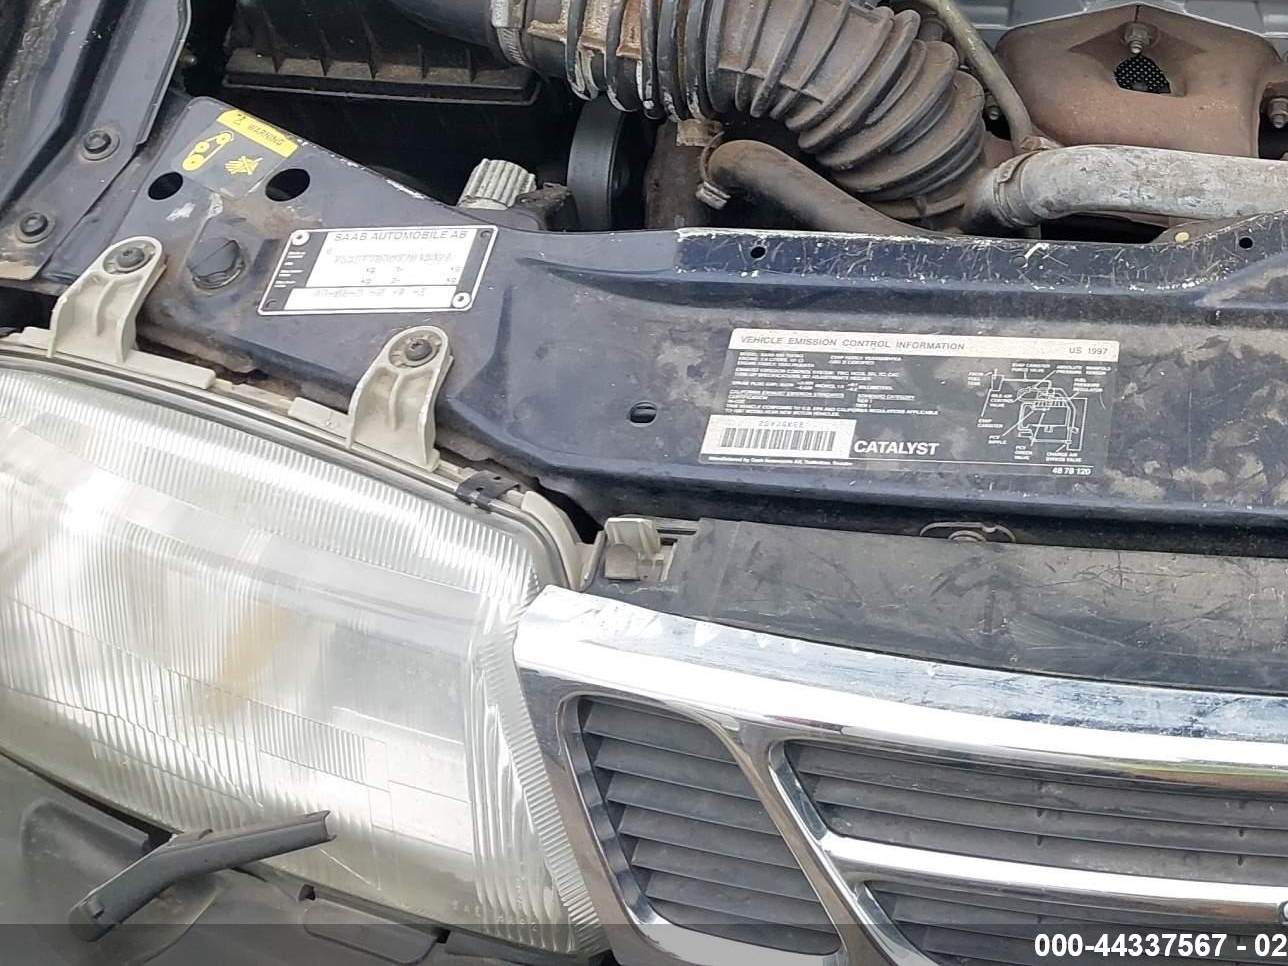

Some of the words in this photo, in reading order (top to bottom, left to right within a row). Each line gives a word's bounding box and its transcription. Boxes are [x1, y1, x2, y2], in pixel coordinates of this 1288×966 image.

[247, 123, 285, 146] WARNING
[334, 233, 368, 241] SAAB
[370, 231, 448, 241] AUTOMOBILE
[450, 230, 467, 238] AB
[740, 336, 783, 344] VEHICLE
[787, 337, 837, 346] EMISSION
[842, 339, 891, 348] CONTROL
[895, 340, 965, 351] INFORMATION
[853, 440, 940, 455] CATALYST
